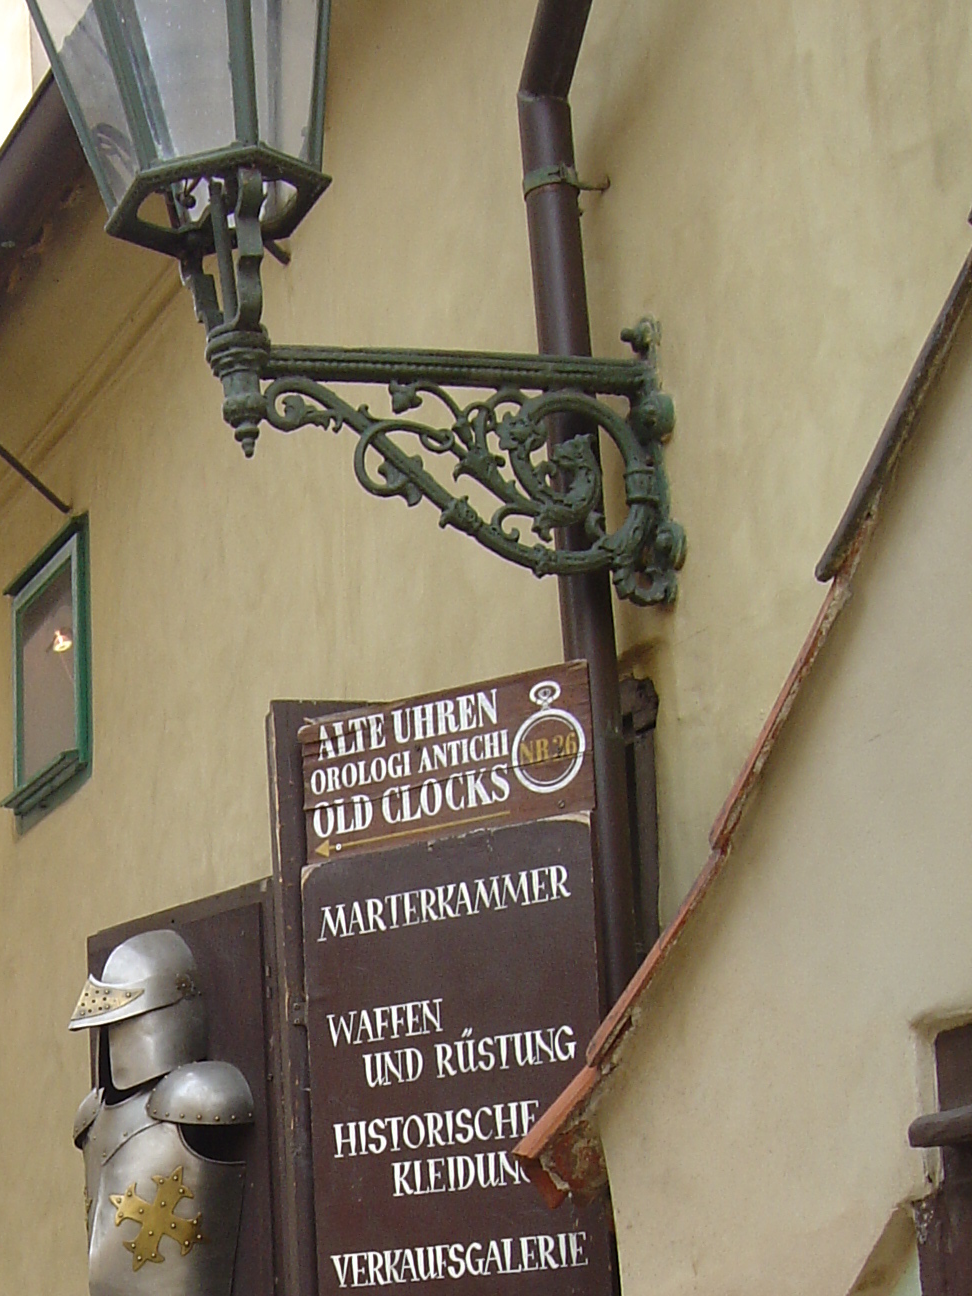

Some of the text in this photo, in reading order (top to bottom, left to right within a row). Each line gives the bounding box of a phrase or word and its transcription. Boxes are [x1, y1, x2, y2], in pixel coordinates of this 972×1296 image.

[318, 688, 499, 762] ALTE UHREN
[552, 731, 577, 762] 26
[310, 729, 510, 796] OROLOGI ANTICHI
[313, 763, 511, 839] OLD CLOCKS
[317, 864, 572, 942] MARTERKAMMER
[326, 998, 443, 1047] WAFFEN
[362, 1026, 577, 1088] UND RÜSTUNG
[333, 1100, 539, 1158] HISTORISCHE
[392, 1151, 531, 1197] KLEIDUN
[330, 1231, 589, 1288] VERKAUFSGALERIE
